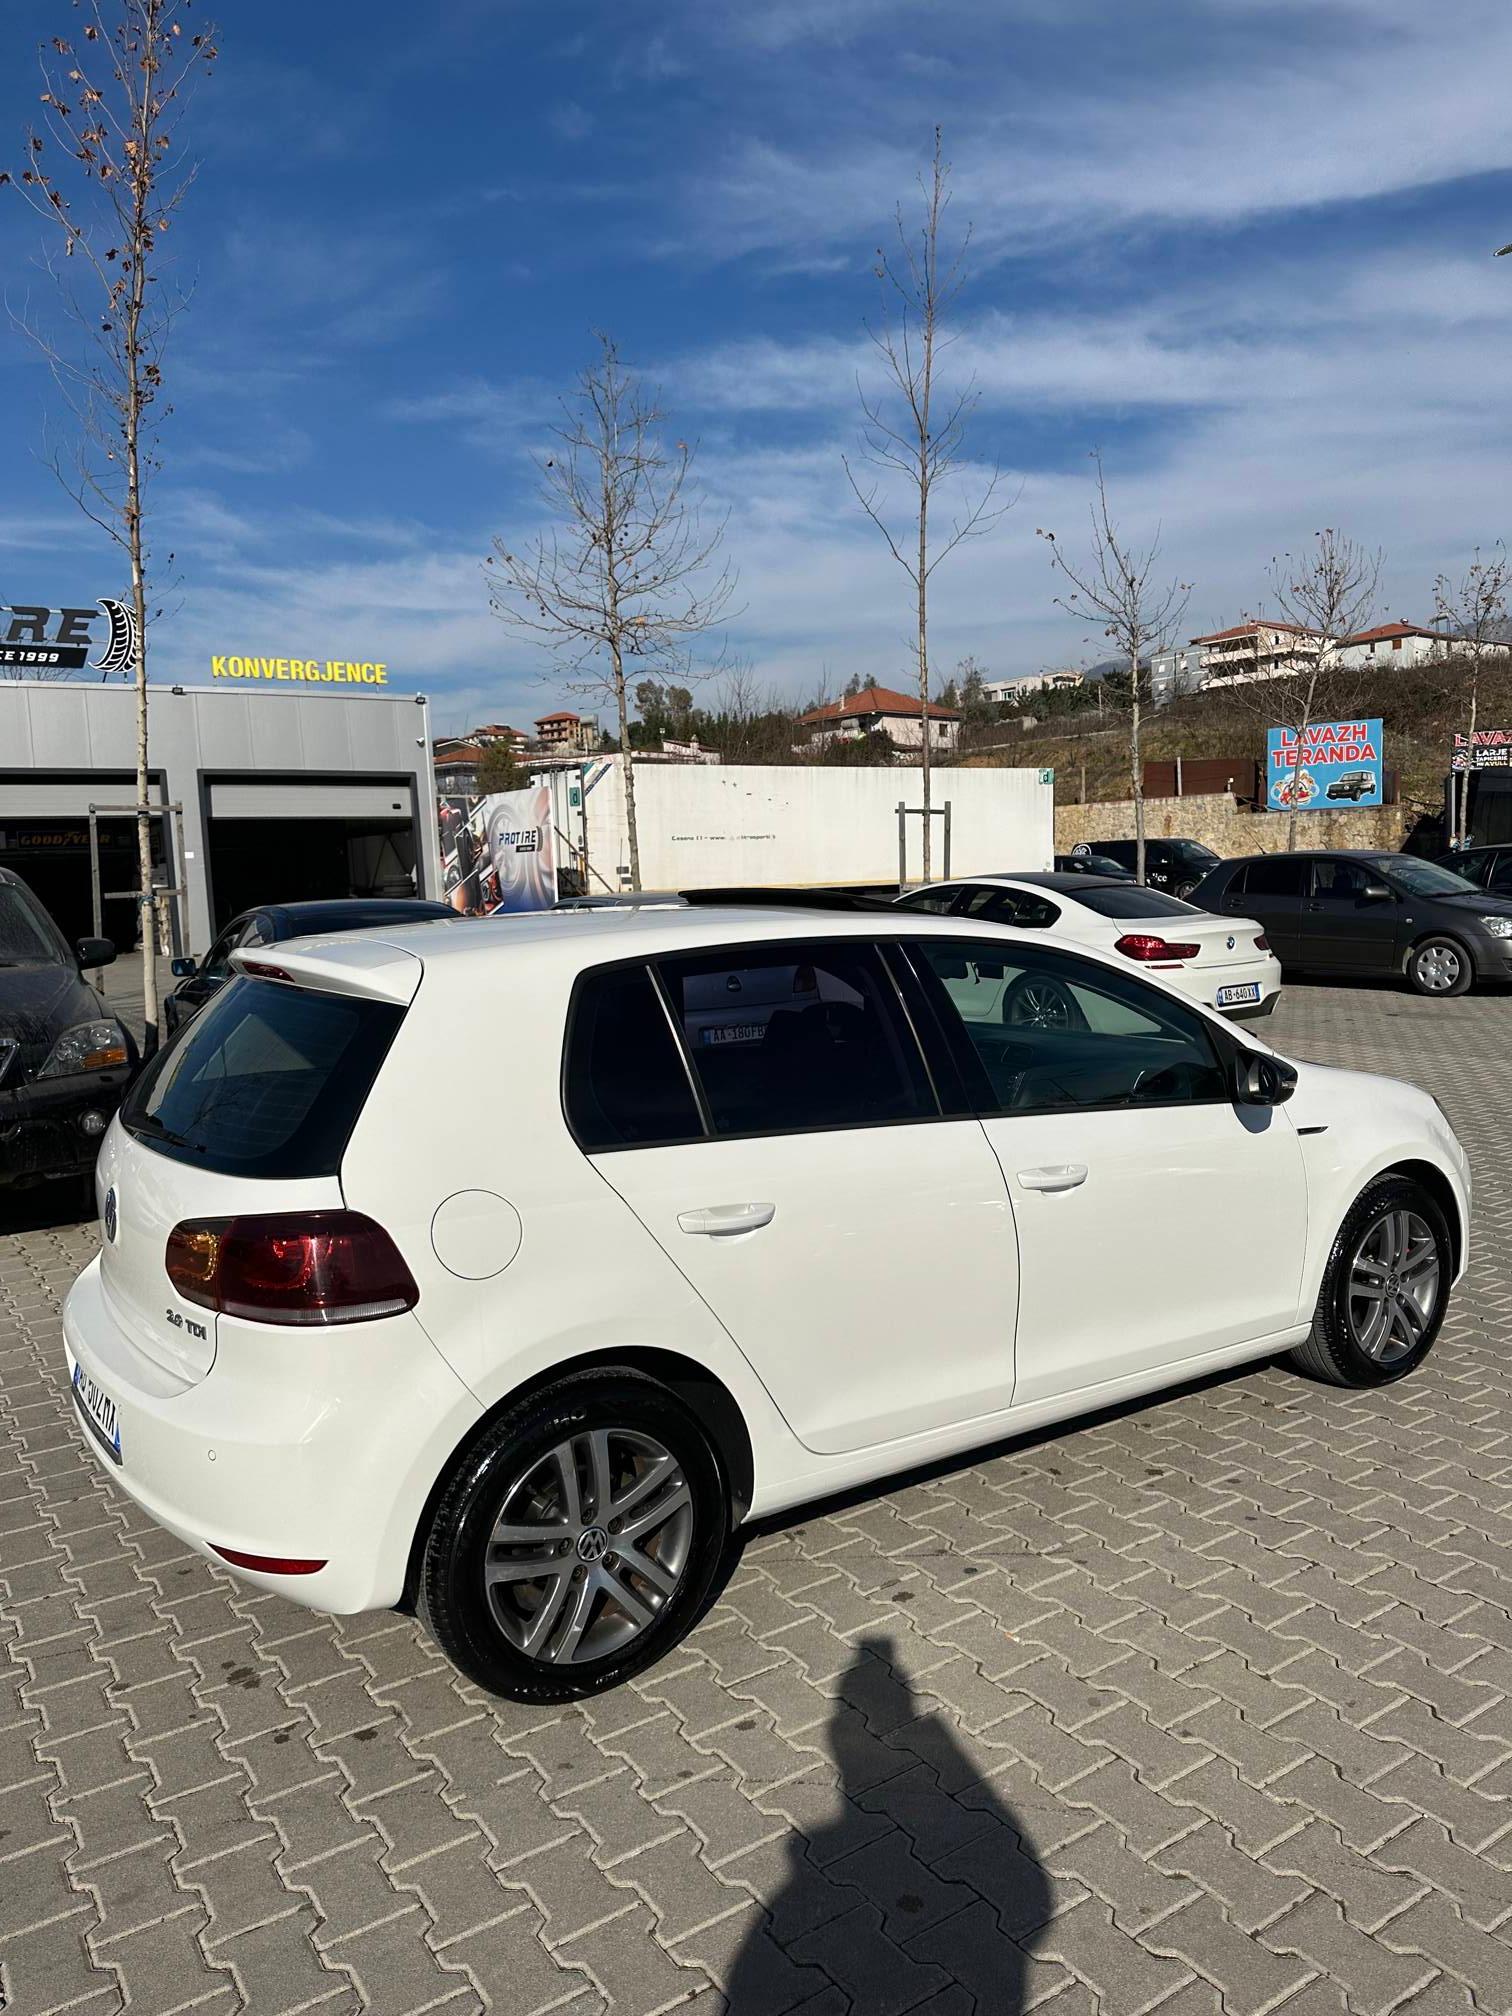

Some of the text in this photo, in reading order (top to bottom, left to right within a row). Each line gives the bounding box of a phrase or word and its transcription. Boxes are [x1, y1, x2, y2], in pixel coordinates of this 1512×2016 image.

[20, 652, 59, 662] 1999
[212, 656, 388, 684] KONVERGJENCE
[1281, 723, 1367, 747] LAVAZH
[1272, 743, 1377, 768] TERANDA
[1476, 748, 1508, 757] LARJE
[498, 830, 537, 845] PROTIRE
[185, 1319, 207, 1340] TDI
